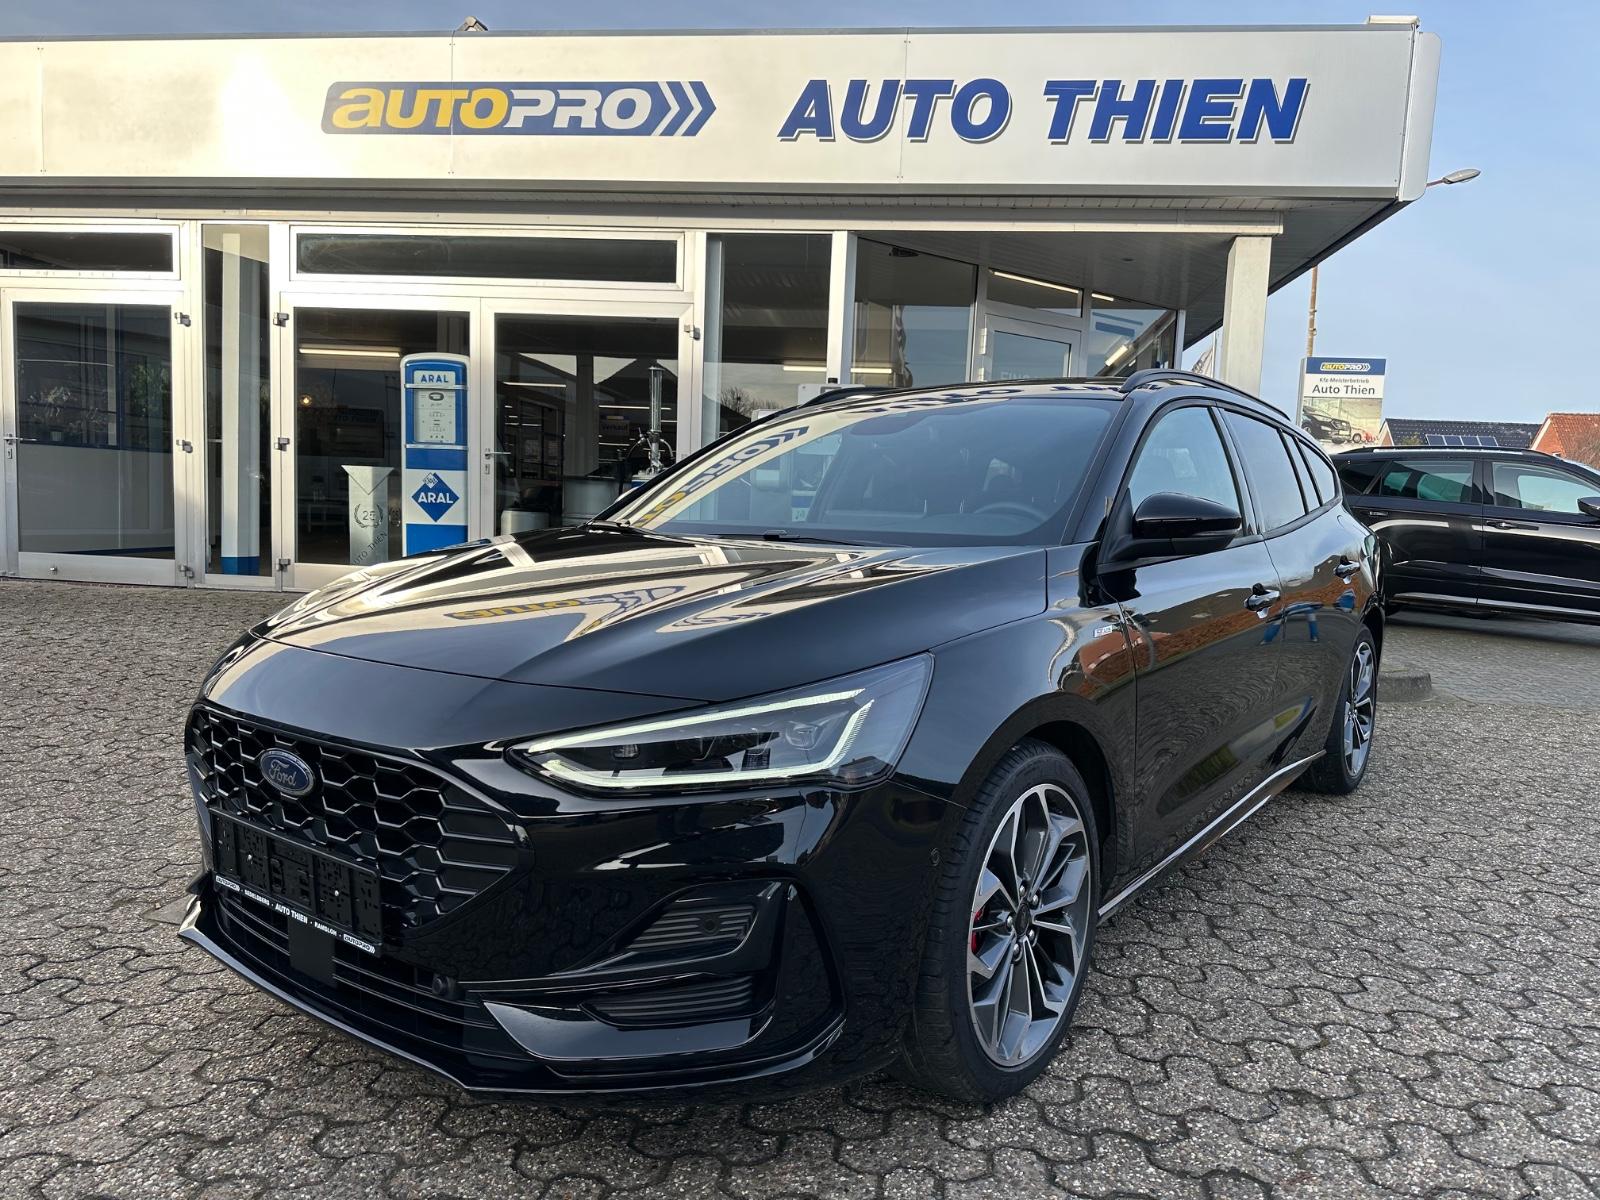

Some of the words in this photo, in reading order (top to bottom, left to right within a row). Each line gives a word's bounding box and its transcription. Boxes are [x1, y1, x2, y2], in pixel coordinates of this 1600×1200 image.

[777, 78, 1013, 144] AUTO
[1043, 78, 1310, 145] THIEN
[420, 374, 449, 383] ARAL
[1312, 384, 1341, 394] Auto
[1343, 385, 1376, 395] Thien
[417, 492, 454, 504] ARAL
[268, 759, 297, 786] Ford
[275, 903, 291, 916] AUTO
[290, 910, 308, 924] THIEN
